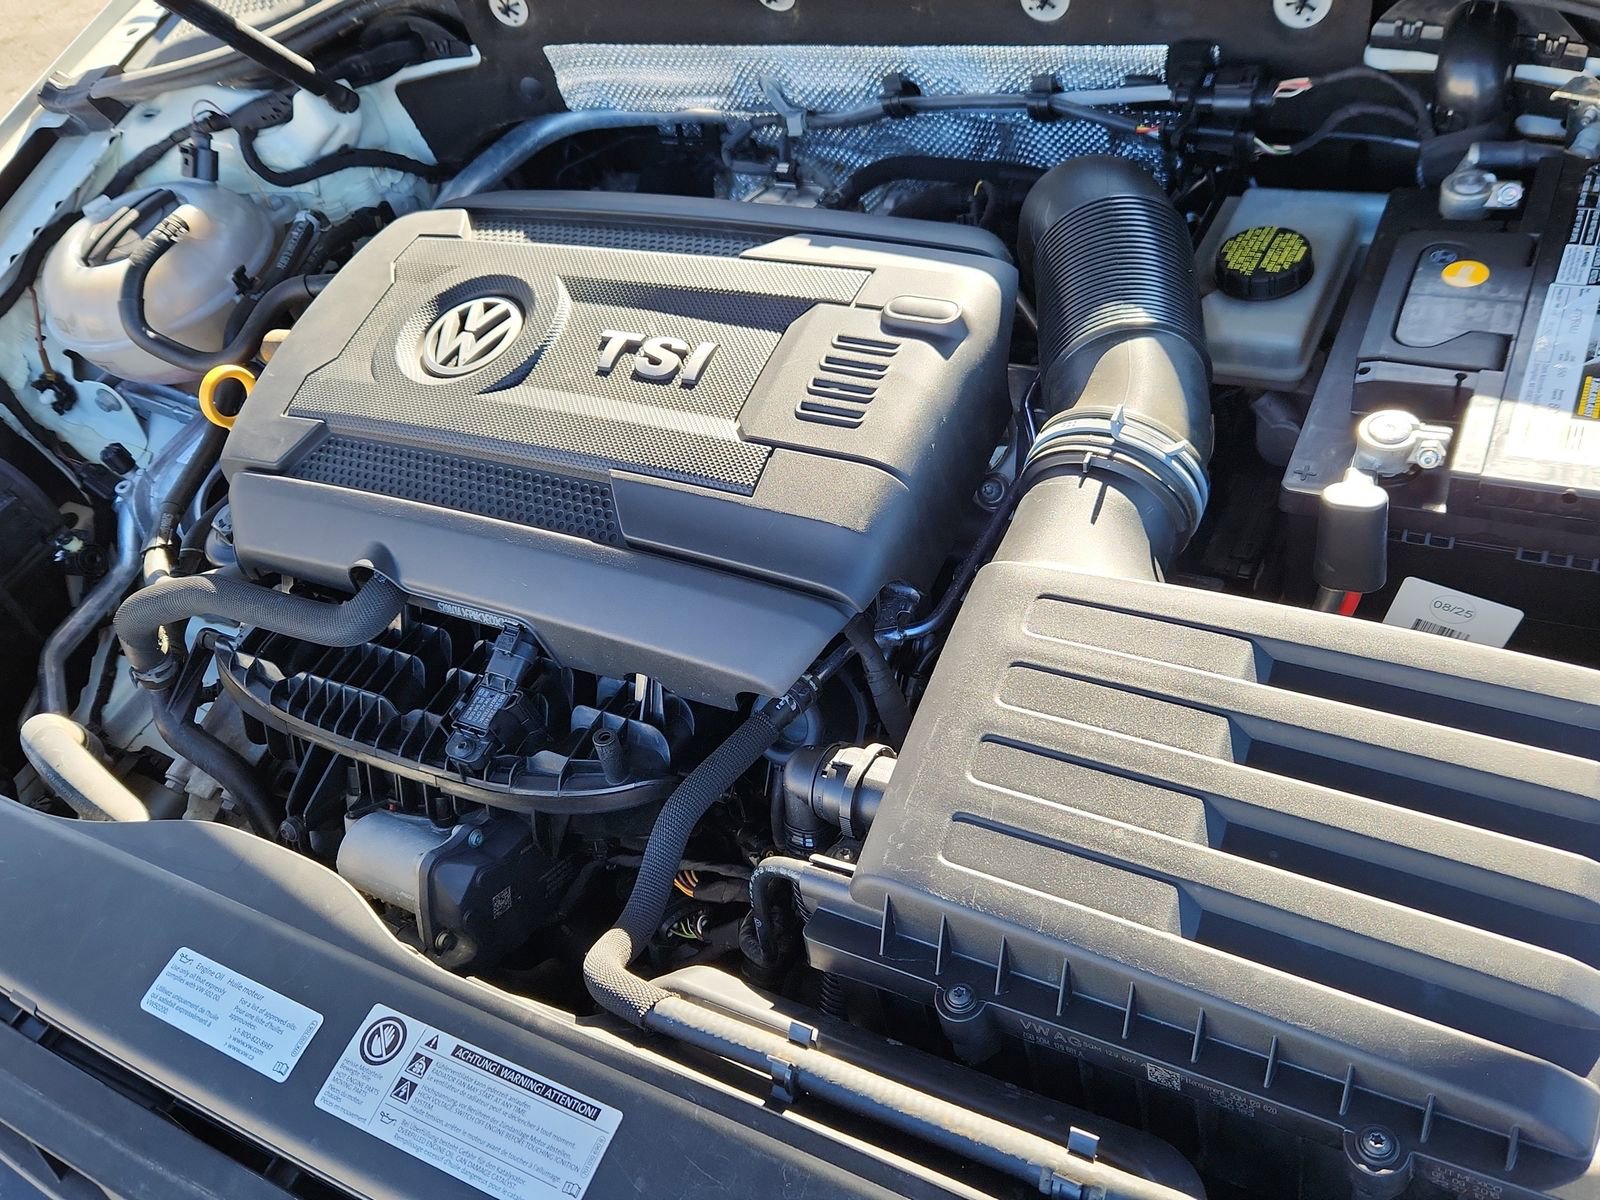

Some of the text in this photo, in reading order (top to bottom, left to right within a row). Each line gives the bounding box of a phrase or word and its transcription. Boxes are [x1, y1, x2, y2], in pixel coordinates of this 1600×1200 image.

[597, 329, 719, 389] TSI
[1433, 600, 1475, 619] 08/25
[179, 968, 190, 978] only
[195, 975, 206, 984] that
[204, 981, 227, 996] expressly
[195, 962, 265, 1001] Engine Oil Huile moteur
[233, 1005, 246, 1015] Pour
[254, 1016, 266, 1026] liste
[238, 997, 248, 1006] For
[250, 1003, 260, 1012] list
[263, 1011, 288, 1026] approved
[1019, 1019, 1050, 1037] VW
[1053, 1031, 1082, 1048] AG
[431, 1067, 457, 1083] RADIATOR
[455, 1079, 467, 1088] FAN
[466, 1084, 479, 1093] MAY
[478, 1089, 494, 1100] START
[454, 1048, 598, 1118] ACHTUNG! WARNING! ATTENTION!
[484, 1123, 505, 1137] ENGINE
[524, 1142, 555, 1161] TOUCHING
[554, 1156, 580, 1173] IGNITION
[529, 1136, 546, 1147] Motor
